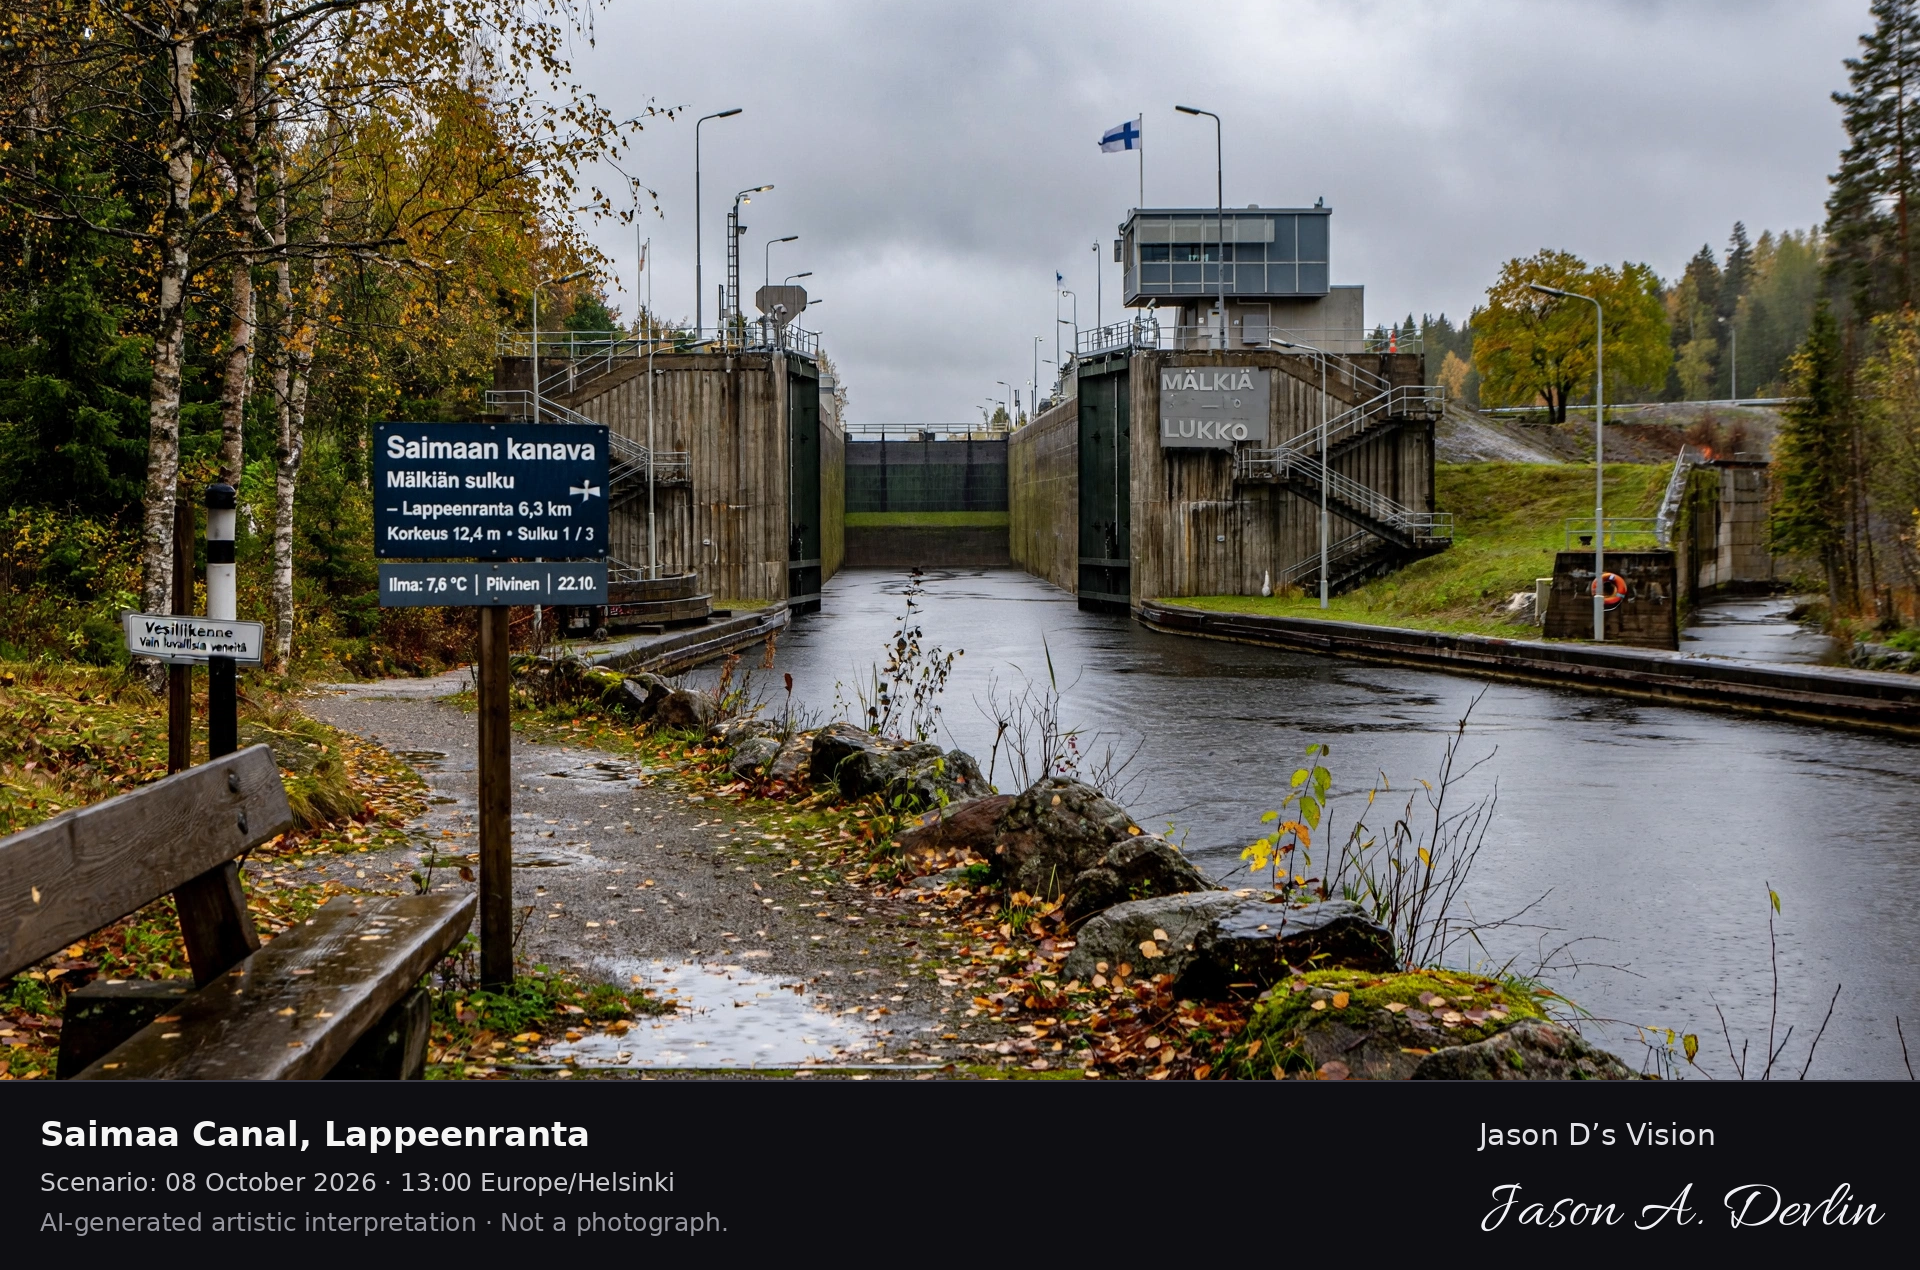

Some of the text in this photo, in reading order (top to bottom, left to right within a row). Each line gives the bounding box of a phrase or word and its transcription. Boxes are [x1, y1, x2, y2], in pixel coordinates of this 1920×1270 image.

[1162, 369, 1255, 391] MÄLKIÄ
[1164, 418, 1248, 441] LUKKO
[386, 434, 596, 461] Saimaan kanava
[387, 471, 515, 490] Mälkiän sulku
[402, 501, 514, 520] Lappeenranta
[518, 501, 544, 519] 6,3
[547, 501, 572, 517] km
[387, 526, 449, 541] Korkeus
[453, 526, 483, 543] 12,4
[487, 530, 501, 541] m
[517, 526, 558, 541] Sulku
[563, 527, 569, 541] 1
[585, 526, 595, 541] 3
[389, 577, 423, 592] Ilma:
[426, 577, 448, 593] 7,6
[450, 576, 468, 592] °C
[486, 576, 540, 592] Pilvinen
[557, 576, 597, 591] 22.10.
